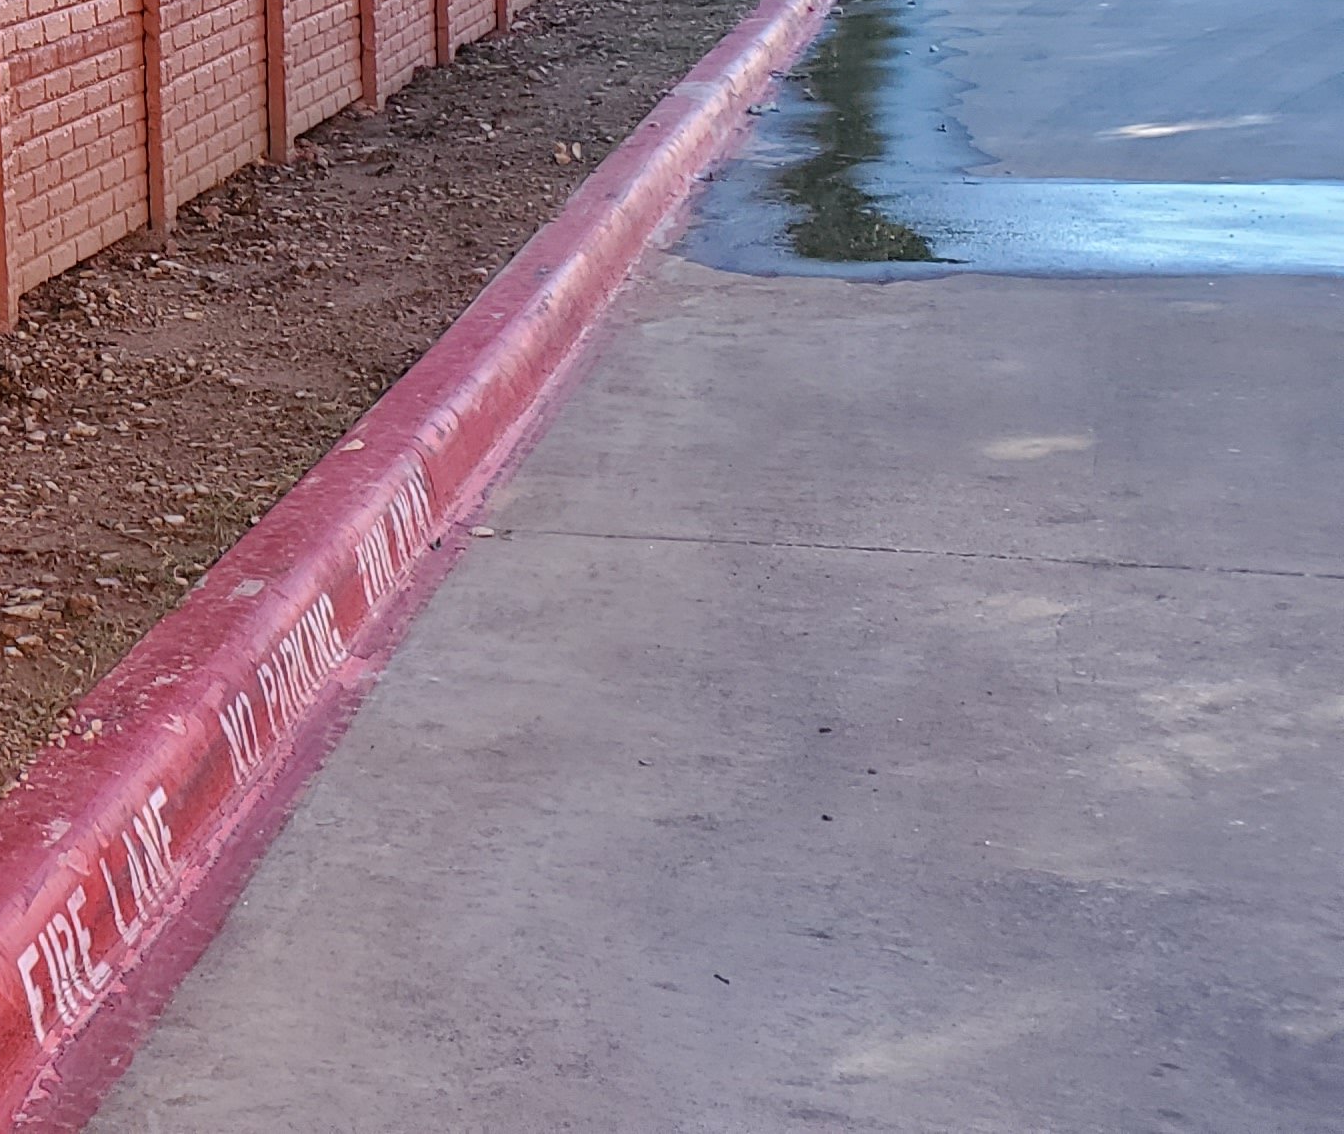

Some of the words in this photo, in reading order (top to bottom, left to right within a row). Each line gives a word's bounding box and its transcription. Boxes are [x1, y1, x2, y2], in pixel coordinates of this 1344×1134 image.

[17, 884, 113, 1046] FIRE
[99, 785, 180, 946] LANE
[219, 692, 262, 786] NO
[257, 593, 348, 743] PARKING
